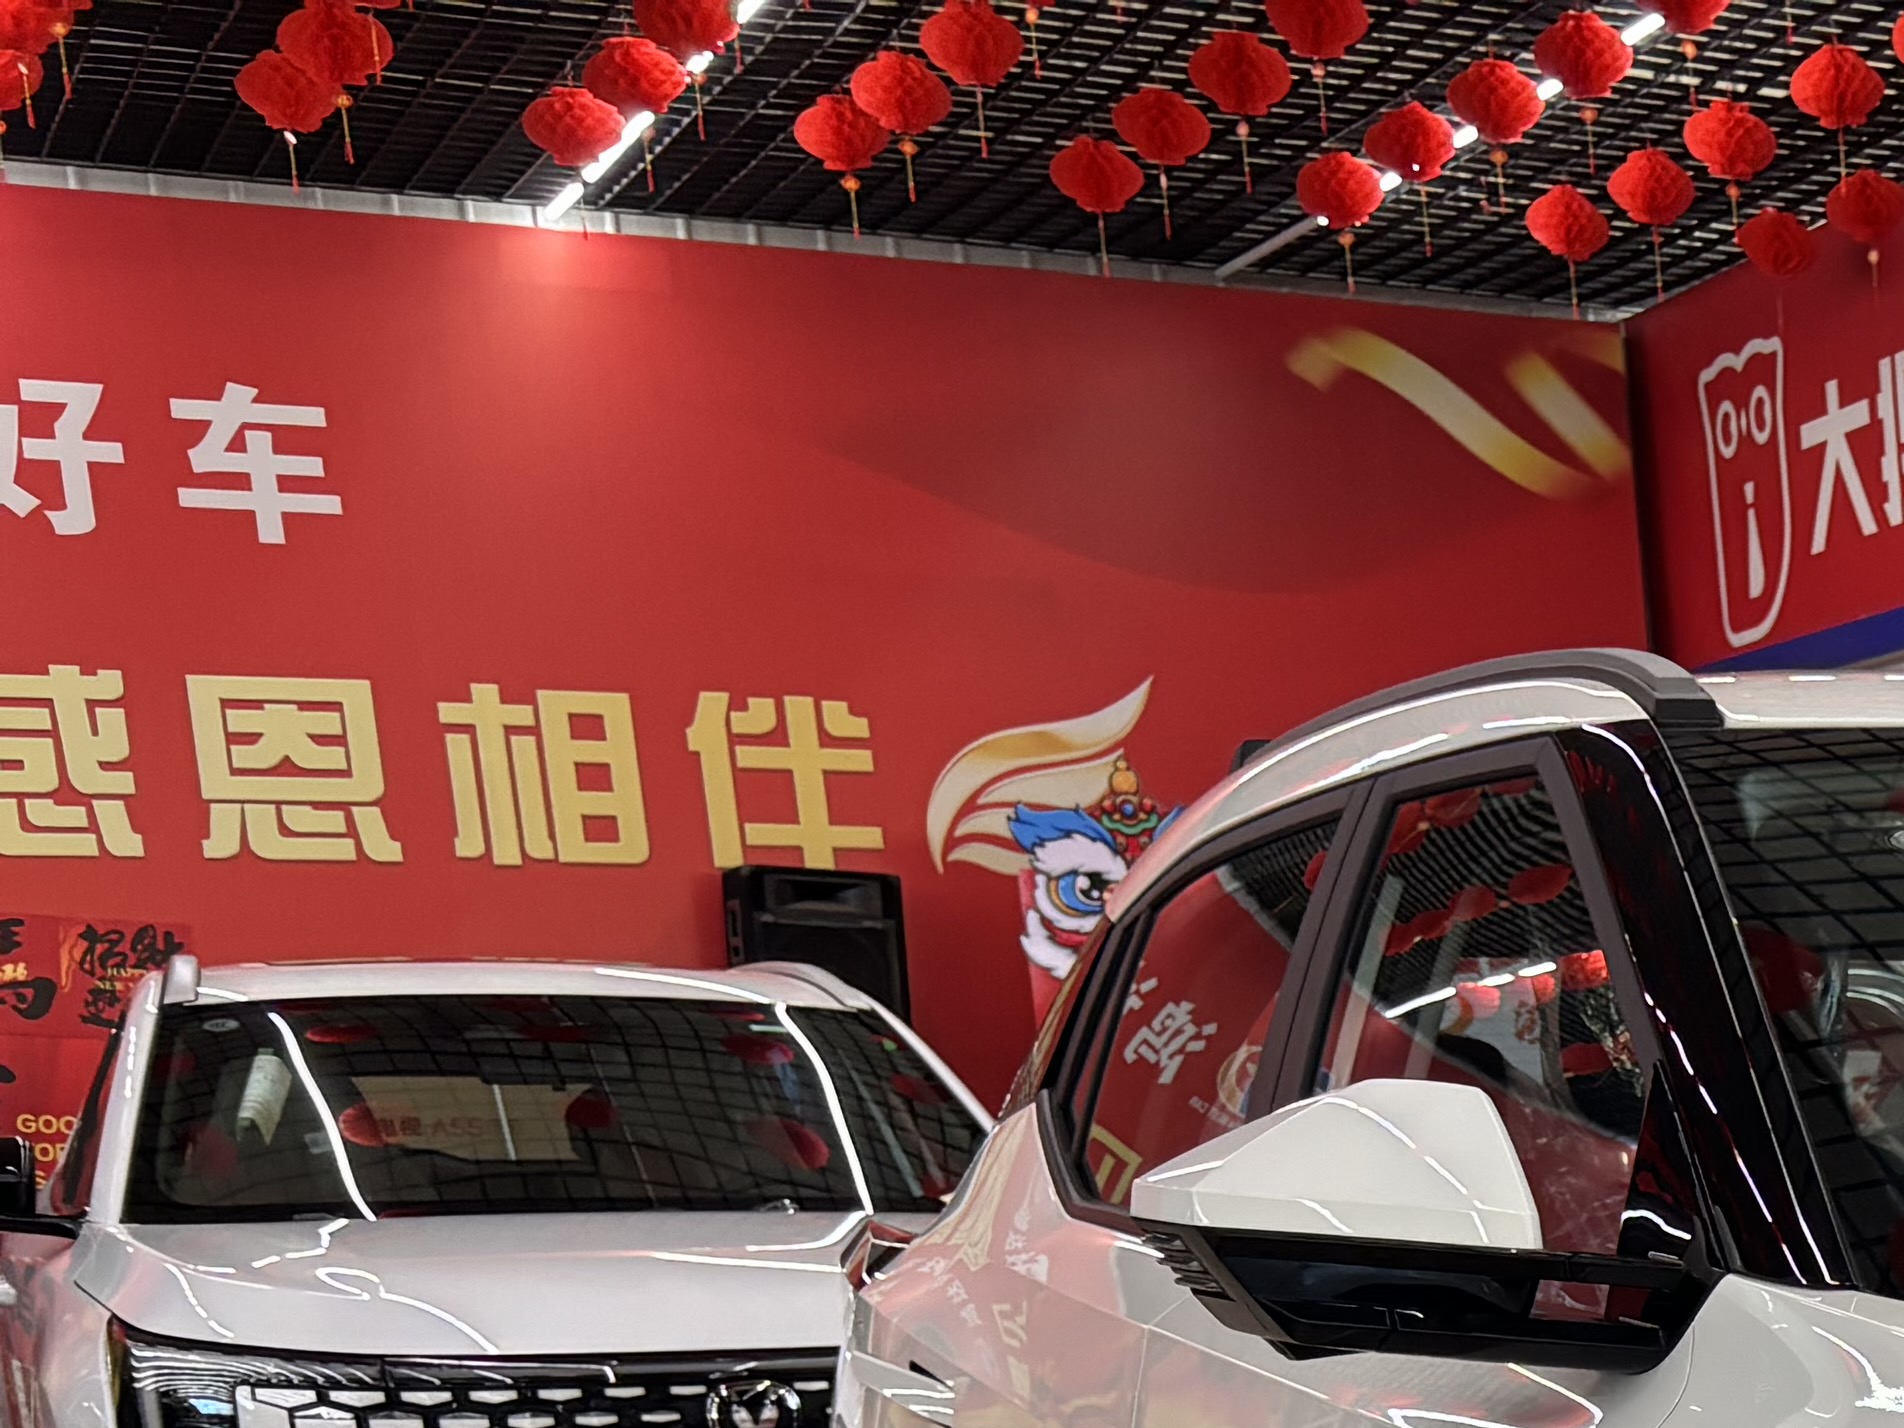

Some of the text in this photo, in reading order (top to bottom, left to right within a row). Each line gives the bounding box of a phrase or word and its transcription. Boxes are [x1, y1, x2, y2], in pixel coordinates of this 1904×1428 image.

[0, 378, 344, 545] 好车
[0, 664, 886, 871] 感恩相伴
[16, 1113, 79, 1134] GOO
